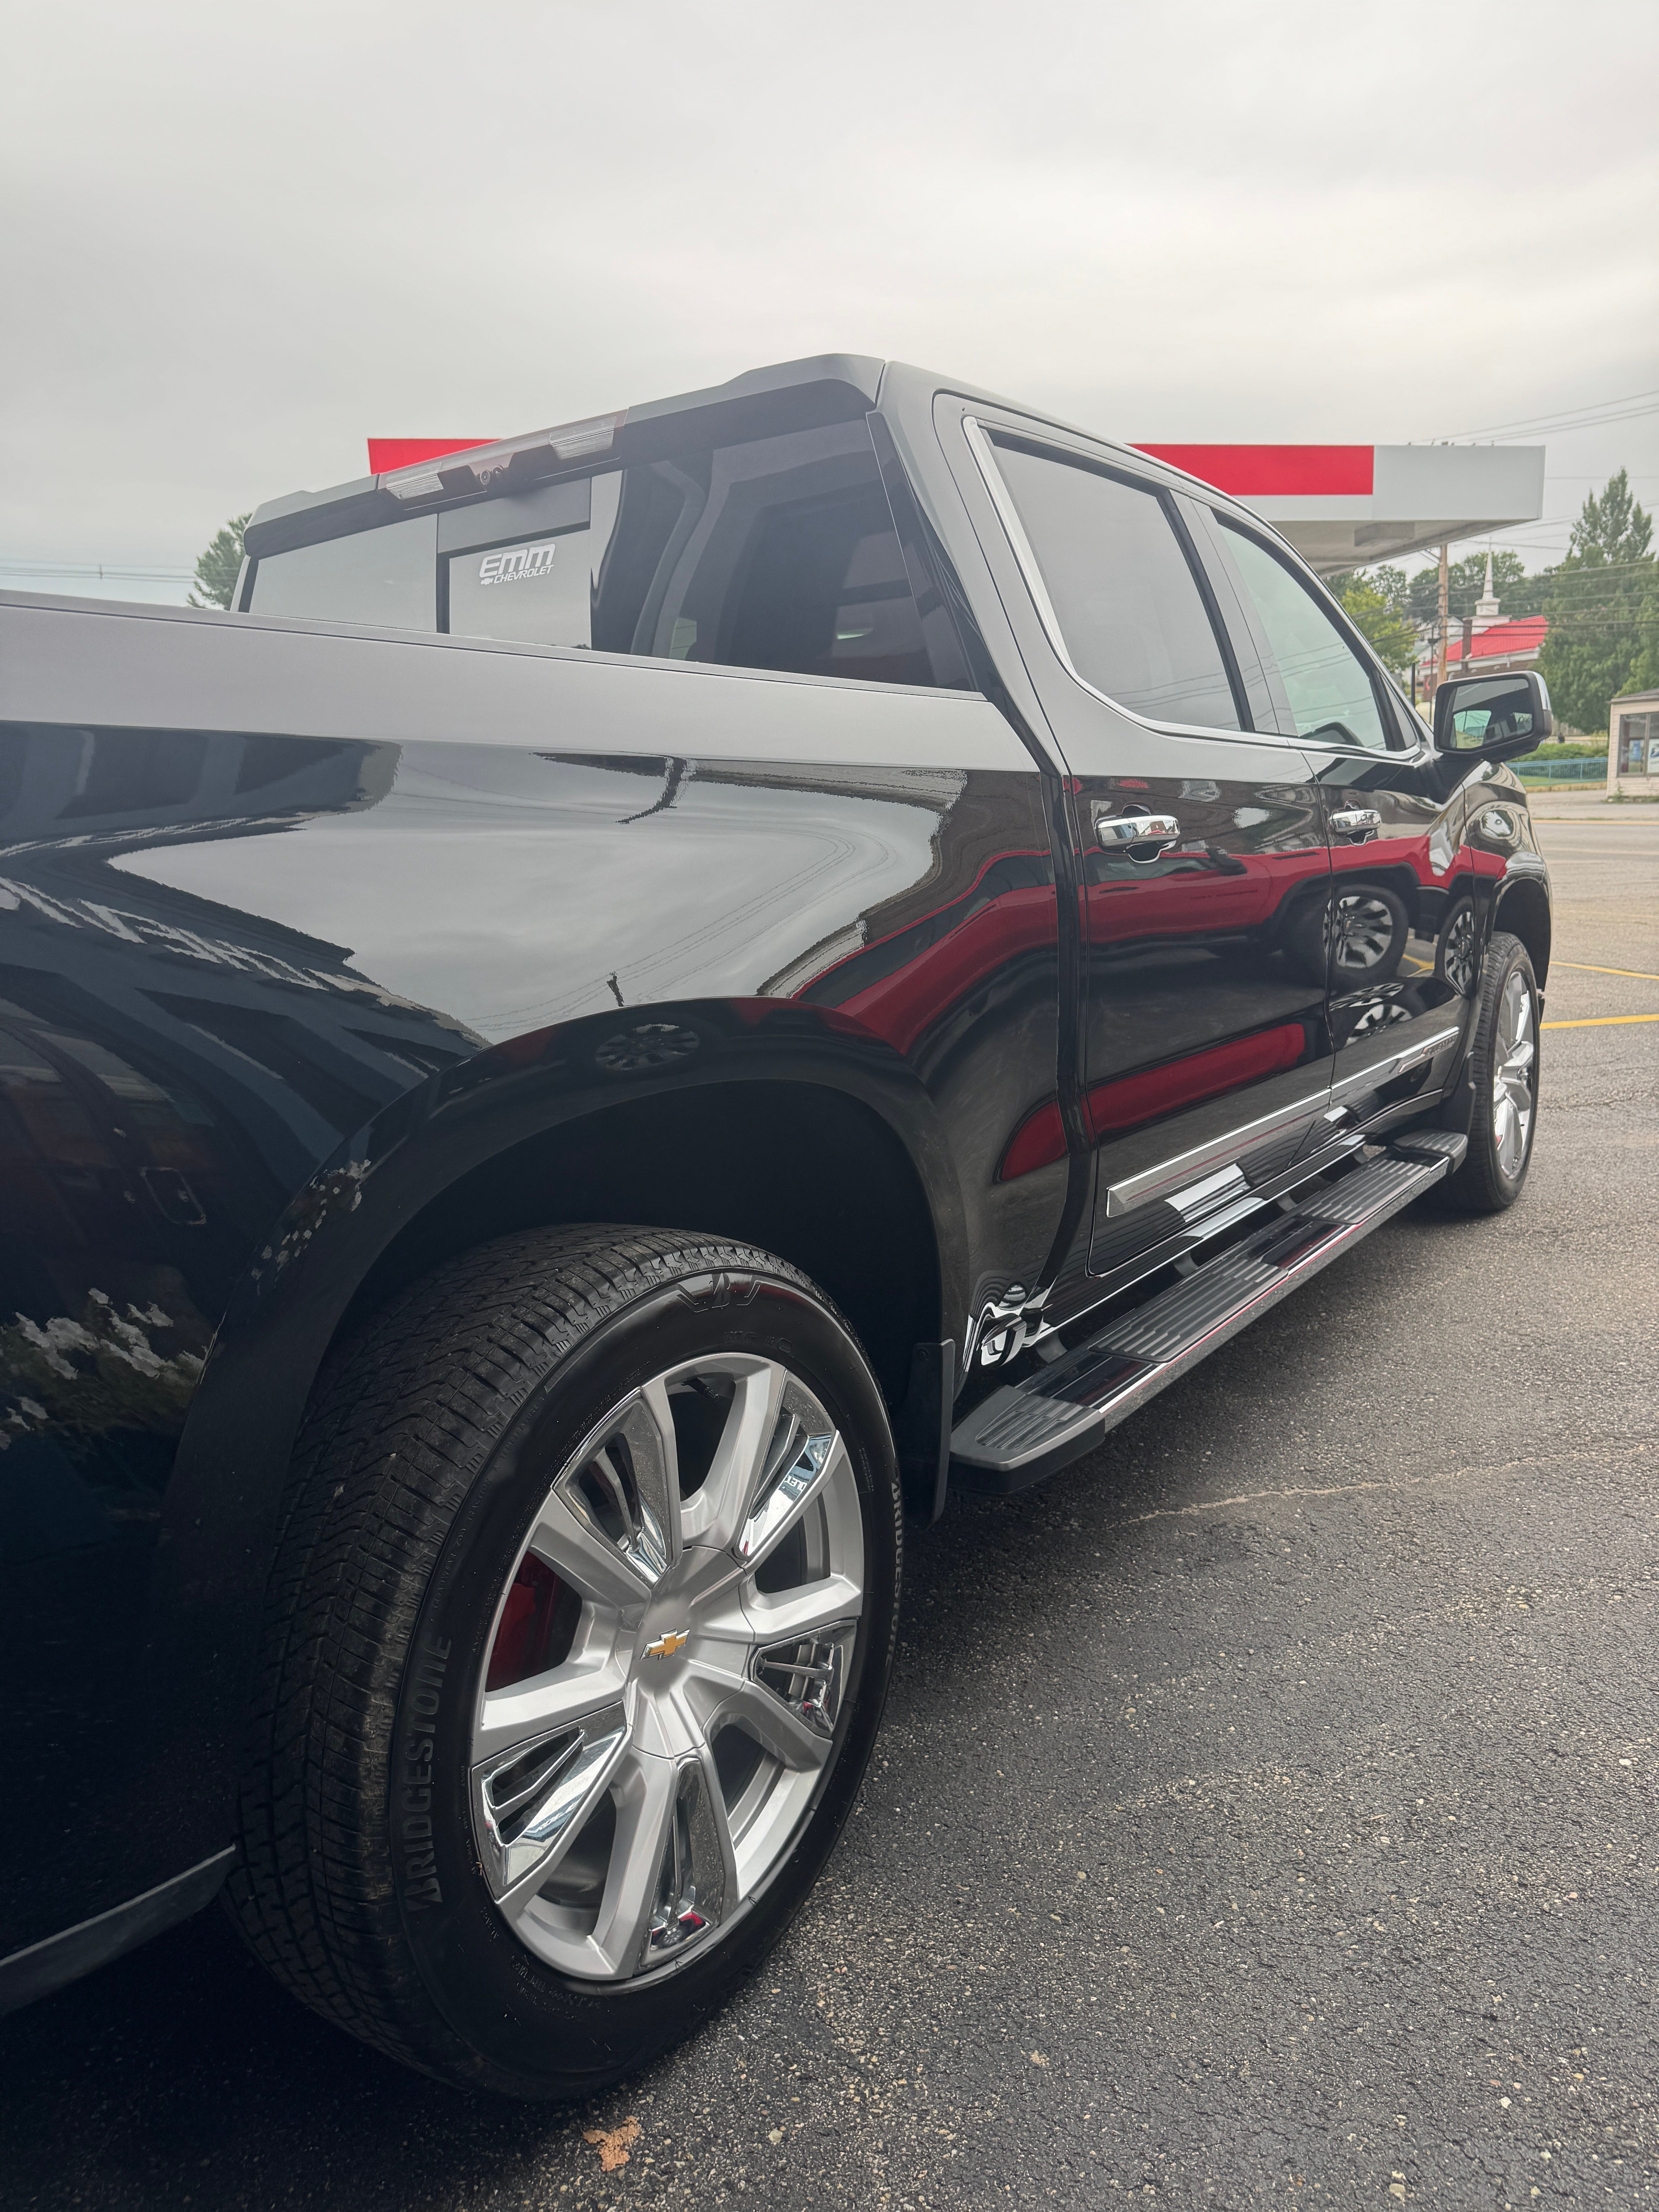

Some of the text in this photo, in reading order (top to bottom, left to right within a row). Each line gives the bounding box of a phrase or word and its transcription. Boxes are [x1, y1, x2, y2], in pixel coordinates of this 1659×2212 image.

[479, 544, 556, 578] EMM
[494, 565, 554, 584] CHEVROLET
[401, 1632, 452, 1911] BRIDGESTONE
